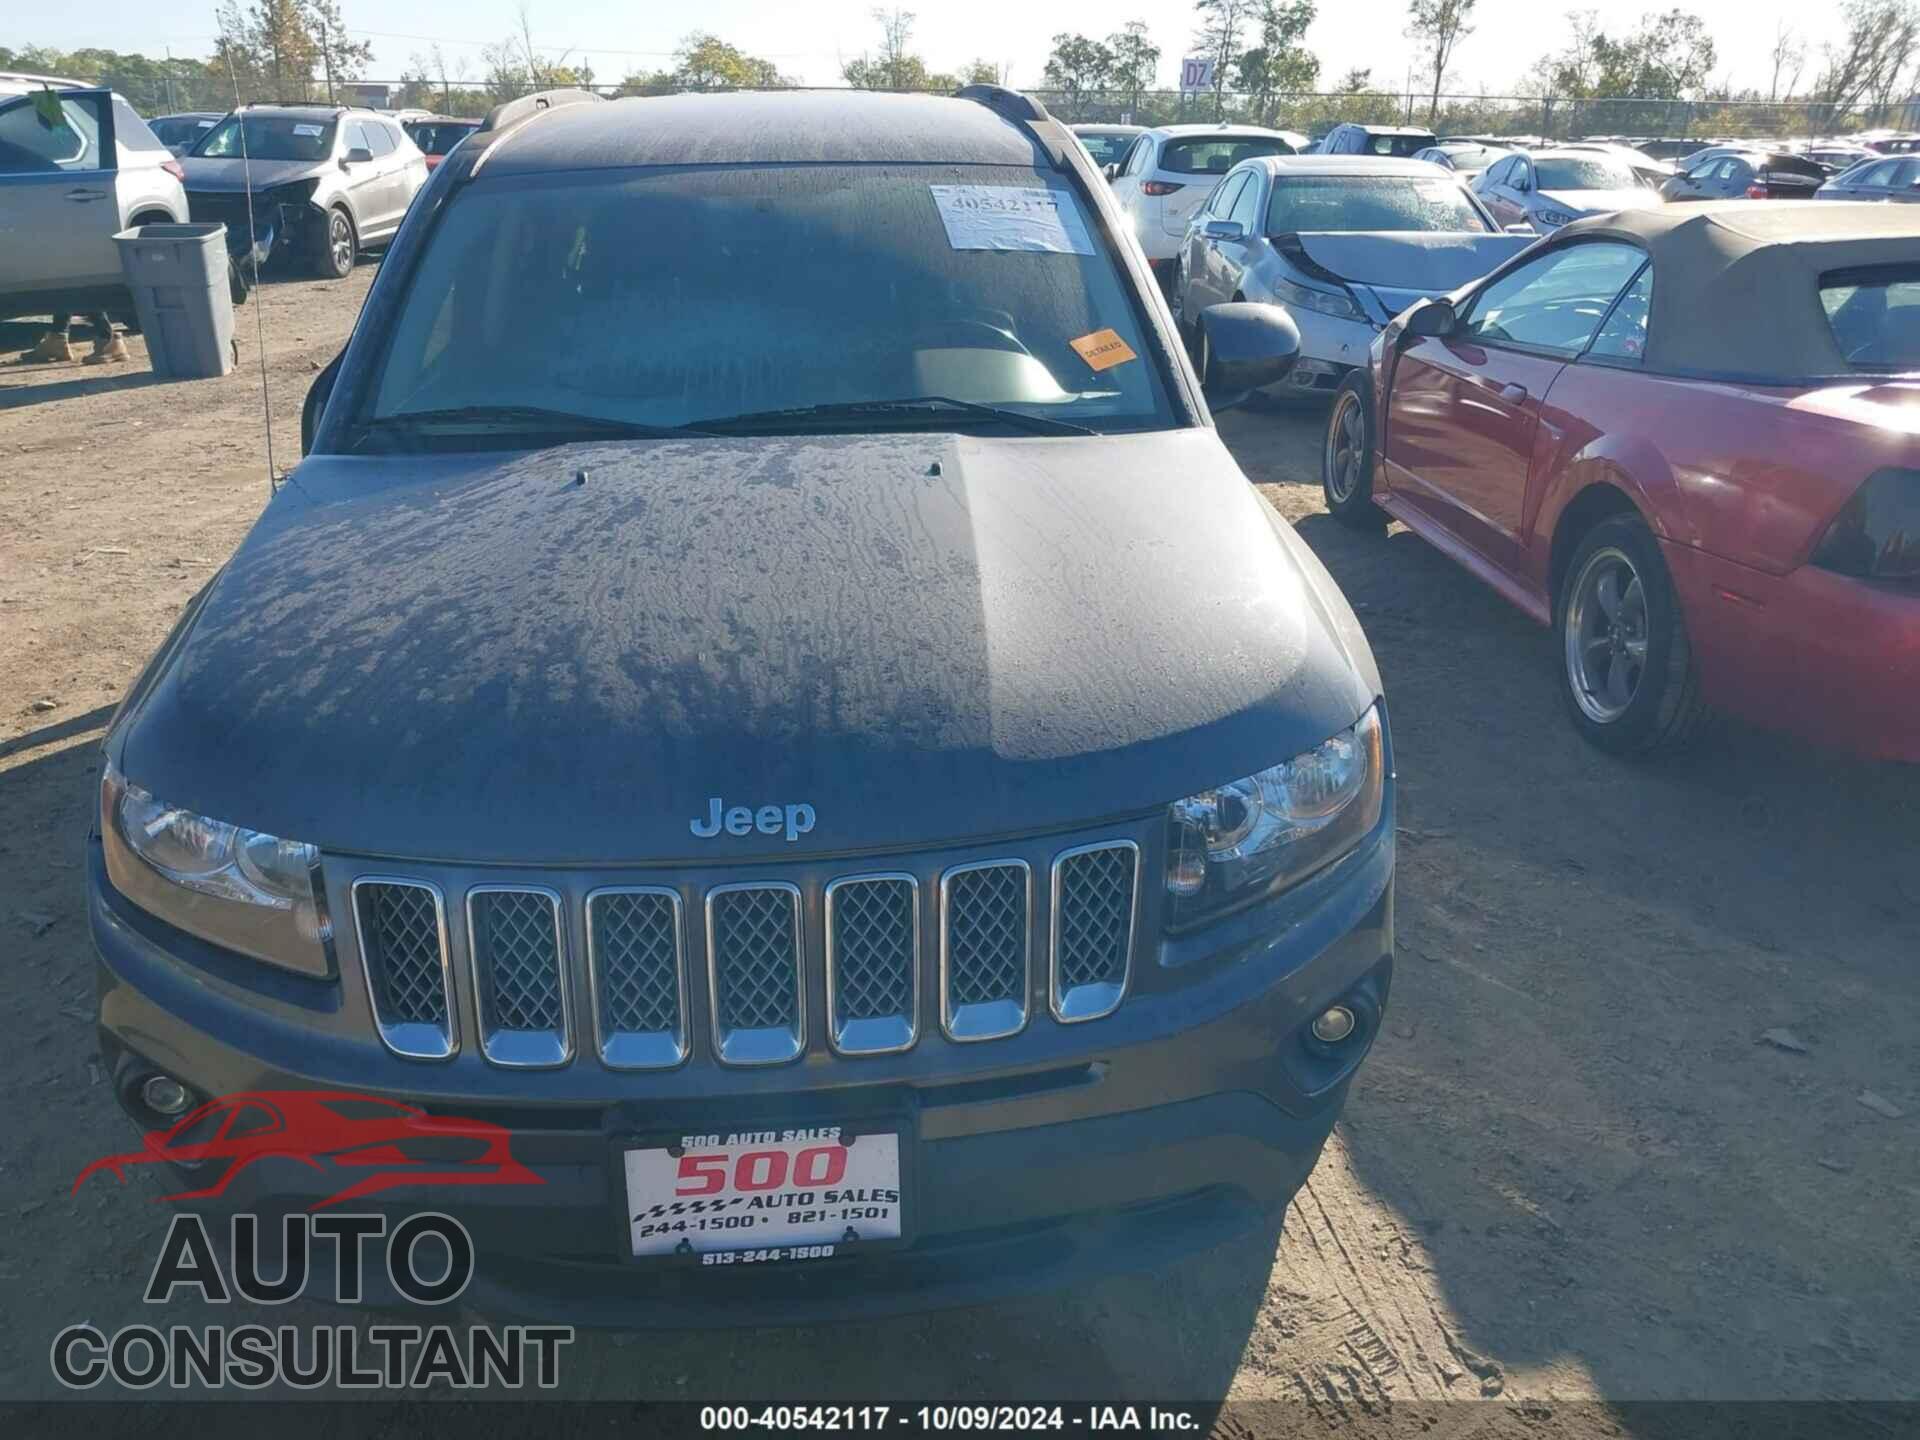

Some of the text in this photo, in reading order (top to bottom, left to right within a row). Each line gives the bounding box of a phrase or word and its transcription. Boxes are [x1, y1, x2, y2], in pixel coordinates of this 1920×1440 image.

[1186, 62, 1208, 87] DZ
[690, 798, 816, 841] Jeep
[681, 1126, 841, 1149] 500 AUTO SALES
[675, 1145, 848, 1196] 500
[746, 1188, 899, 1210] AUTO SALES
[640, 1207, 889, 1238] 244-1500 821-1501
[702, 1244, 835, 1266] 513-244-1500
